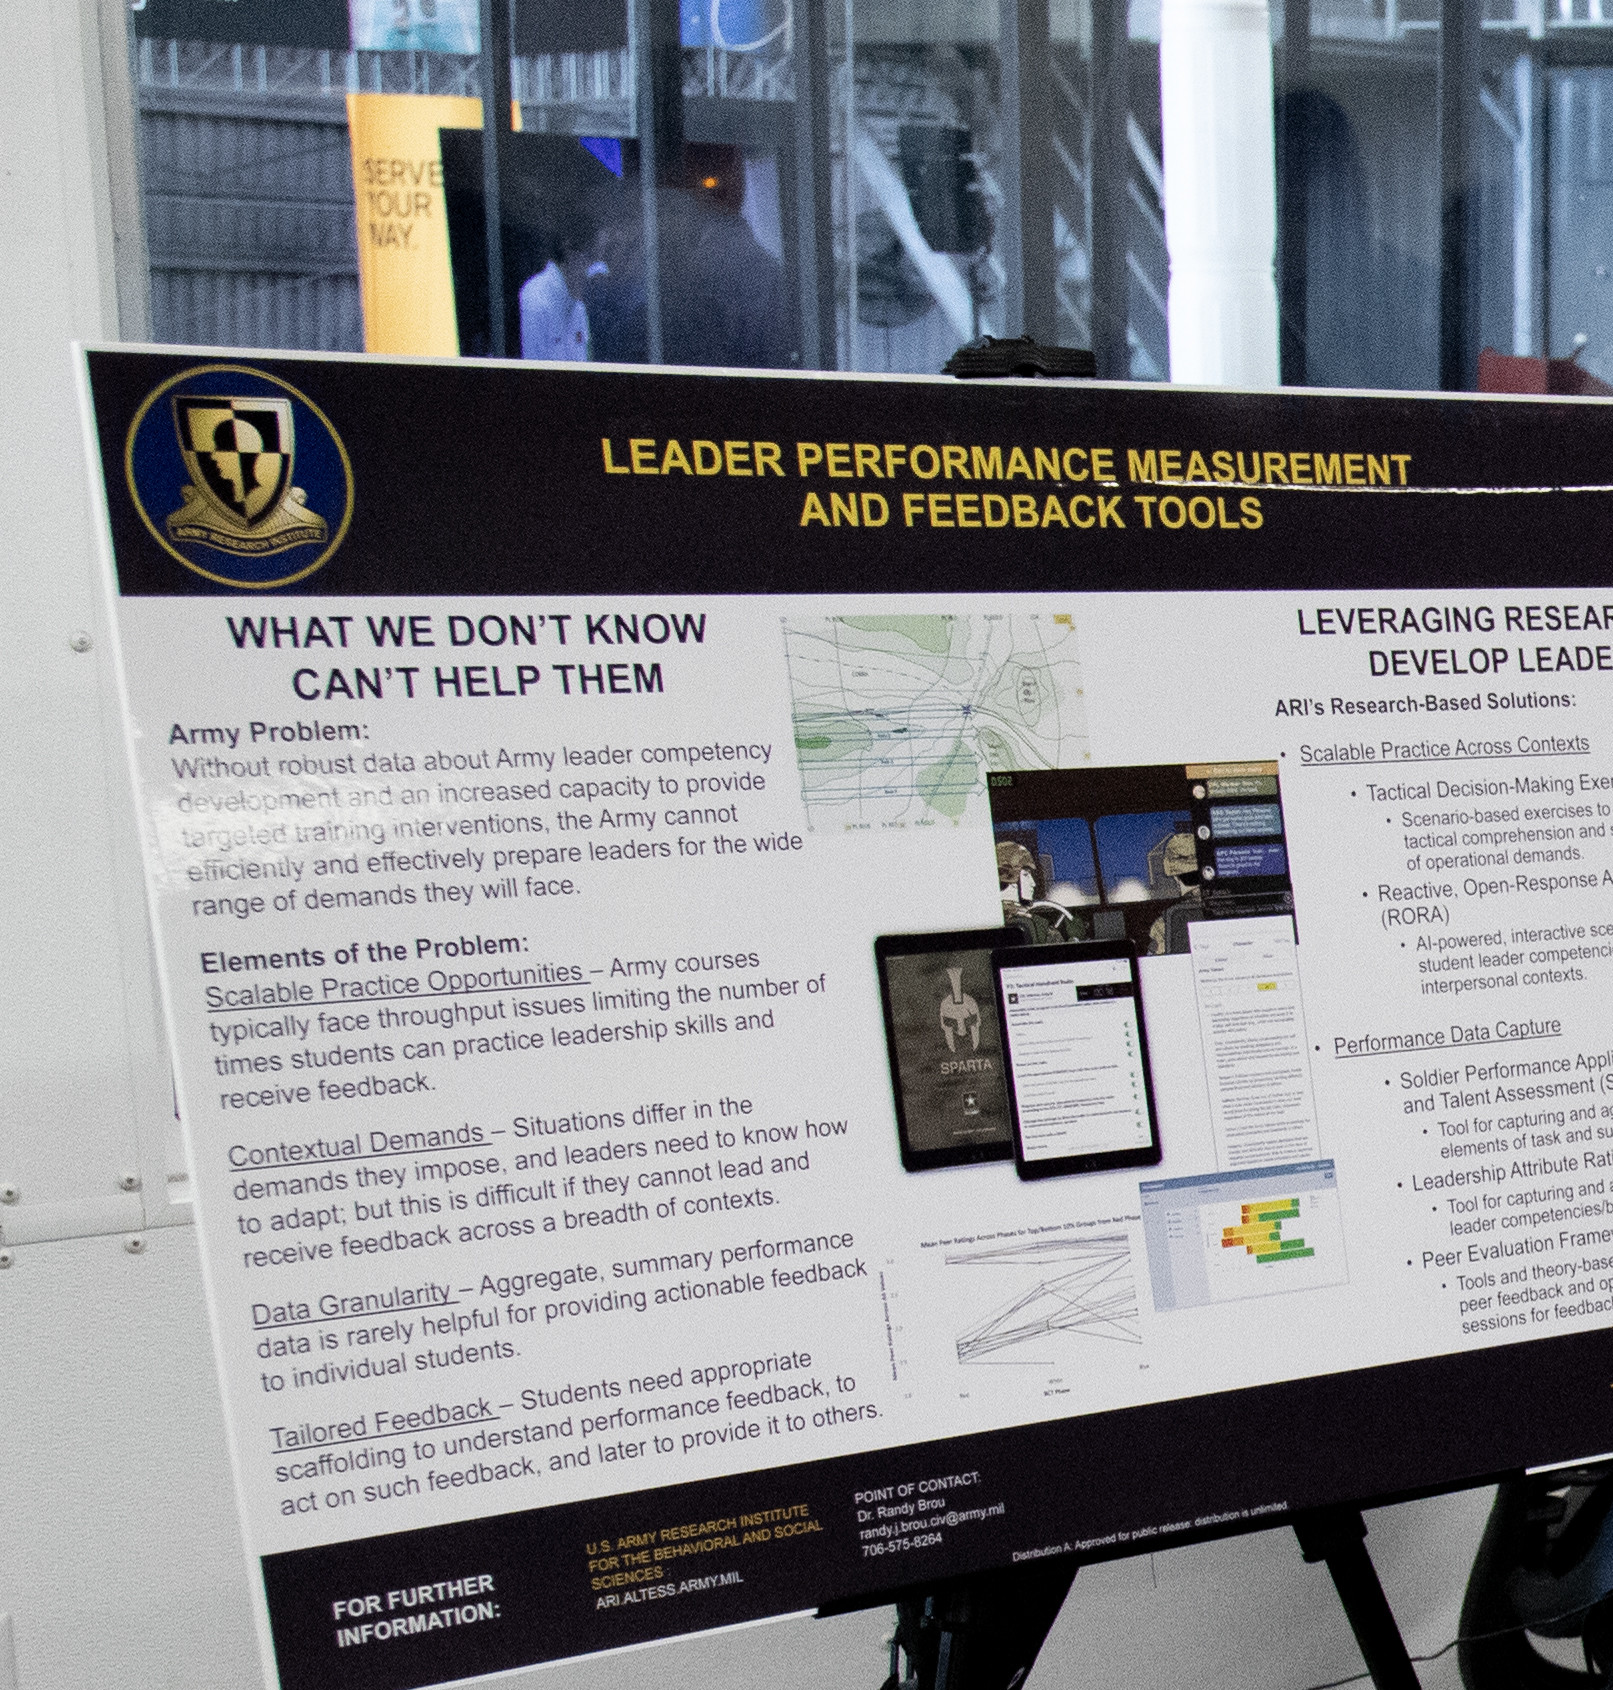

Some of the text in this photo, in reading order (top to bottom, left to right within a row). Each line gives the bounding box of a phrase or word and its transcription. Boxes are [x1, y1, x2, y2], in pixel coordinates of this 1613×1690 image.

[601, 437, 1412, 486] LEADER PERFORMANCE MEASUREMENT
[799, 491, 1263, 529] AND FEEDBACK TOOLS
[225, 613, 706, 648] WHAT WE DON’T KNOW
[1297, 605, 1495, 635] LEVERAGING
[1368, 647, 1508, 676] DEVELOP
[292, 662, 663, 700] CAN’T HELP THEM
[1330, 693, 1481, 714] Research-Based
[1486, 691, 1576, 710] Solutions:
[168, 719, 369, 749] Army Problem:
[1299, 734, 1590, 763] Scalable Practice Across Contexts
[191, 875, 580, 920] range of demands they will face.
[199, 934, 528, 974] Elements of the Problem:
[1418, 954, 1474, 973] student
[1477, 950, 1524, 967] leader
[1333, 1018, 1562, 1055] Performance Data Capture
[940, 1058, 993, 1075] SPARTA
[219, 1070, 435, 1109] receive feedback.
[242, 1187, 779, 1268] receive feedback across a breadth of contexts.
[1421, 1250, 1462, 1269] Peer
[1467, 1236, 1554, 1262] Evaluation
[1461, 1312, 1527, 1334] sessions
[1529, 1306, 1550, 1322] for
[854, 1486, 894, 1504] POINT
[896, 1482, 915, 1497] OF
[876, 1501, 915, 1518] Randy
[916, 1498, 945, 1511] Brou
[585, 1503, 809, 1555] U.S. ARMY RESEARCH INSTITUTE
[588, 1519, 823, 1572] FOR THE BEHAVIORAL AND SOCIAL
[861, 1531, 942, 1556] 706-575-8264
[1074, 1532, 1116, 1549] Approved
[1117, 1531, 1130, 1541] for
[590, 1565, 664, 1590] SCIENCES
[332, 1573, 495, 1620] FOR FURTHER
[336, 1600, 500, 1647] INFORMATION:
